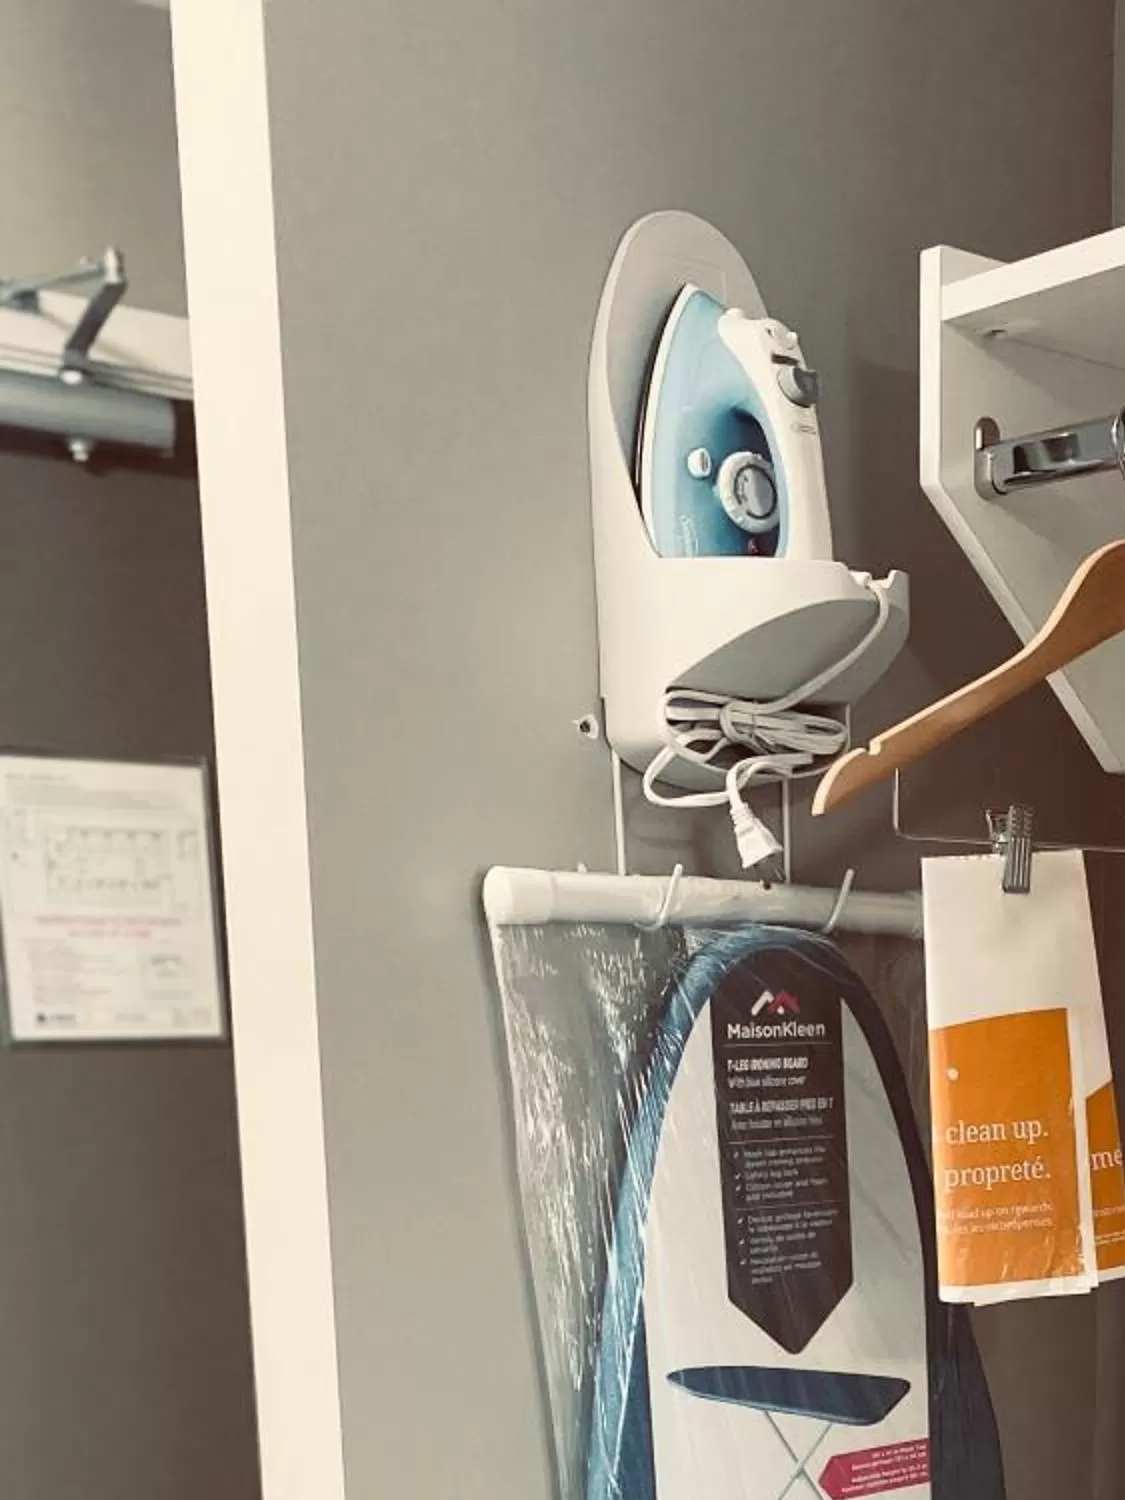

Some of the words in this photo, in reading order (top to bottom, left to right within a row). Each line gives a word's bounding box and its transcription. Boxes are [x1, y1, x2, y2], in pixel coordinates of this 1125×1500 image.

[727, 1022, 825, 1039] MaisonKleen
[945, 1119, 1007, 1145] clean
[1012, 1119, 1049, 1145] up.
[944, 1155, 1052, 1194] propreté.
